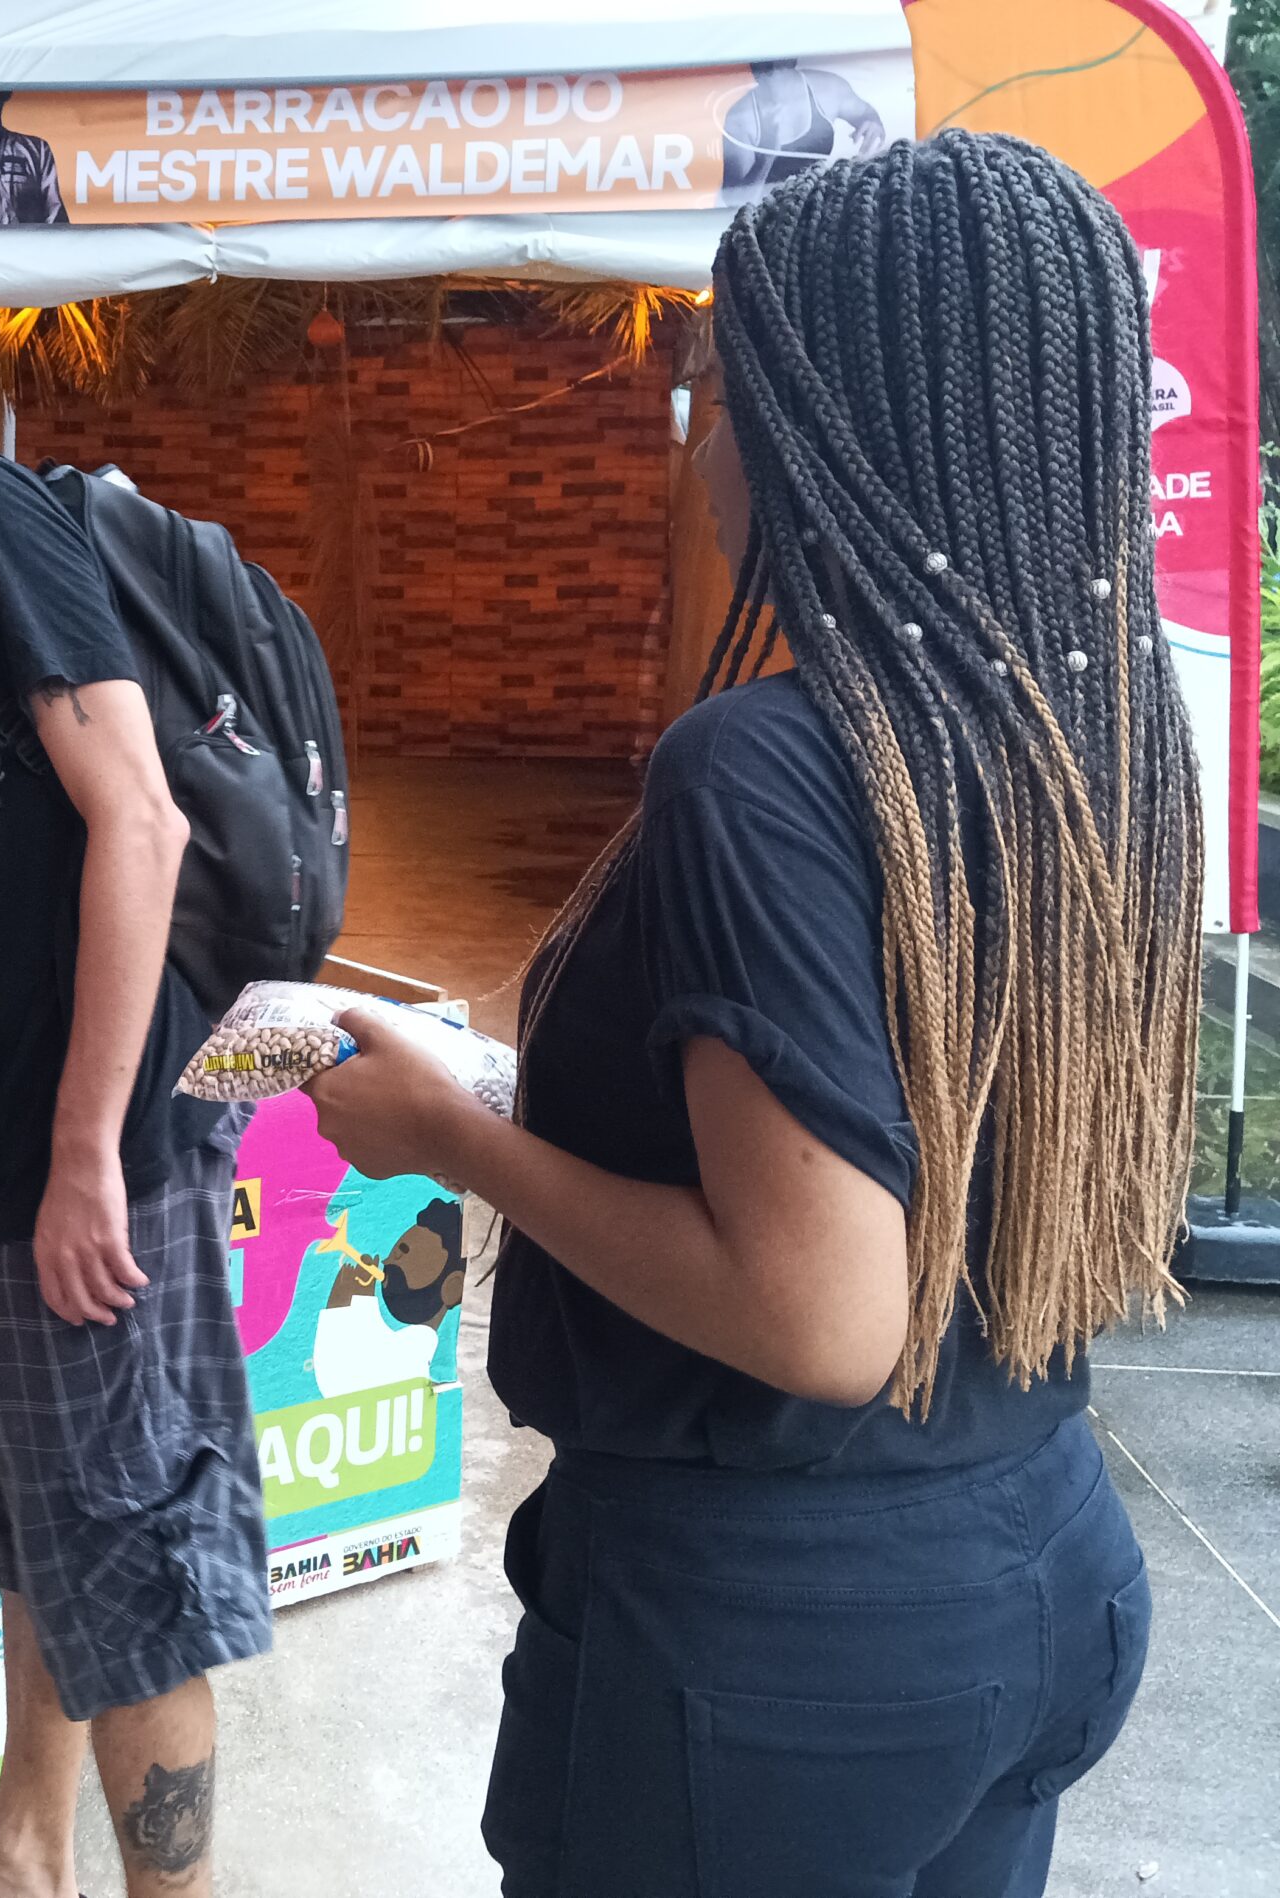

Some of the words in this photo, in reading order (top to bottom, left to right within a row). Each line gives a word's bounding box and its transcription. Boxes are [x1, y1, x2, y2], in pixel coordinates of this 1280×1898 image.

[525, 72, 624, 125] DO
[75, 147, 309, 204] MESTRE
[321, 134, 694, 199] WALDEMAR
[257, 1387, 424, 1489] AQUI!
[343, 1537, 381, 1553] GOVERNO
[381, 1533, 392, 1543] DO
[394, 1526, 422, 1540] ESTADO
[343, 1535, 420, 1576] BAHIA
[269, 1579, 297, 1596] sem
[300, 1569, 331, 1588] fome
[270, 1553, 331, 1583] BAHIA
